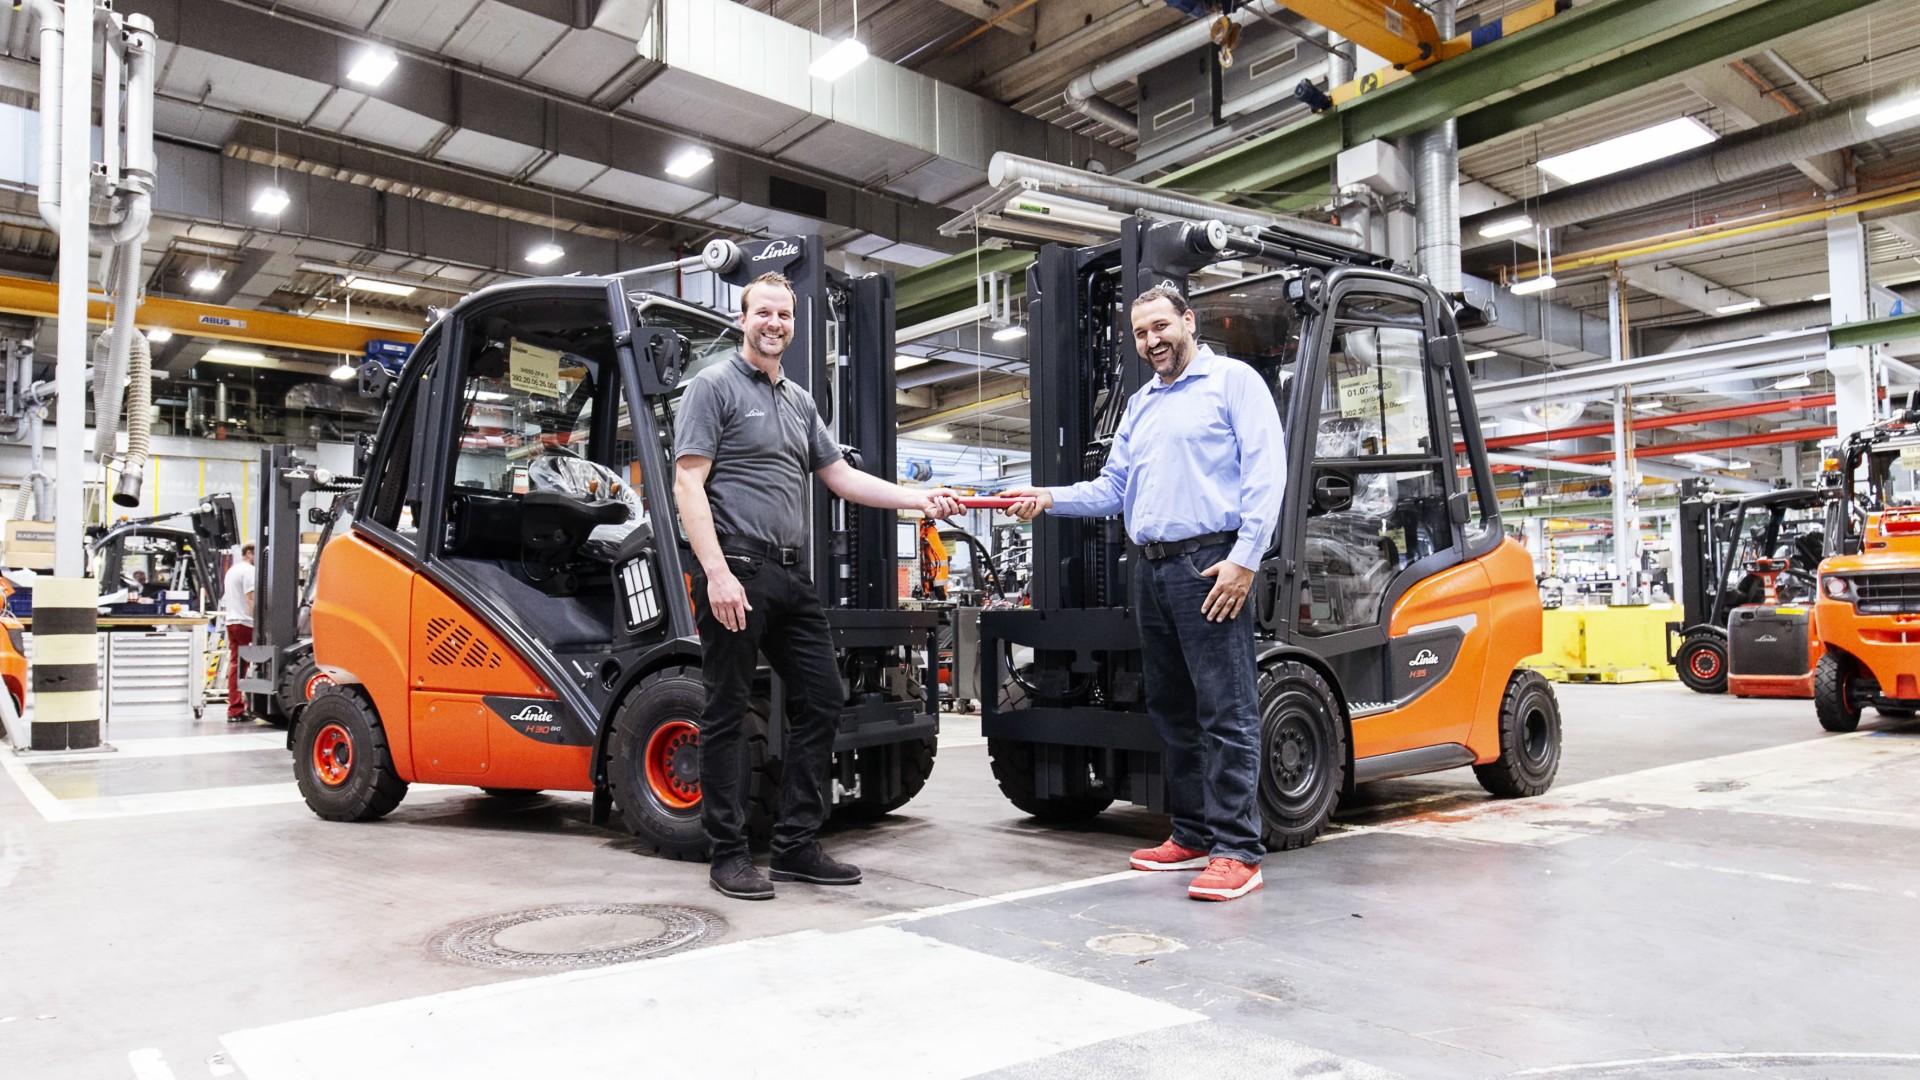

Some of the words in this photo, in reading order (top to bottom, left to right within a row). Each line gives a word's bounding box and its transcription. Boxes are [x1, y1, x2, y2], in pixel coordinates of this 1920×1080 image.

[752, 240, 798, 261] Linde
[201, 316, 230, 326] ABUS
[1347, 381, 1392, 397] 01.07.220
[1408, 649, 1439, 667] Linde
[510, 704, 553, 722] Linde
[525, 725, 550, 734] H30
